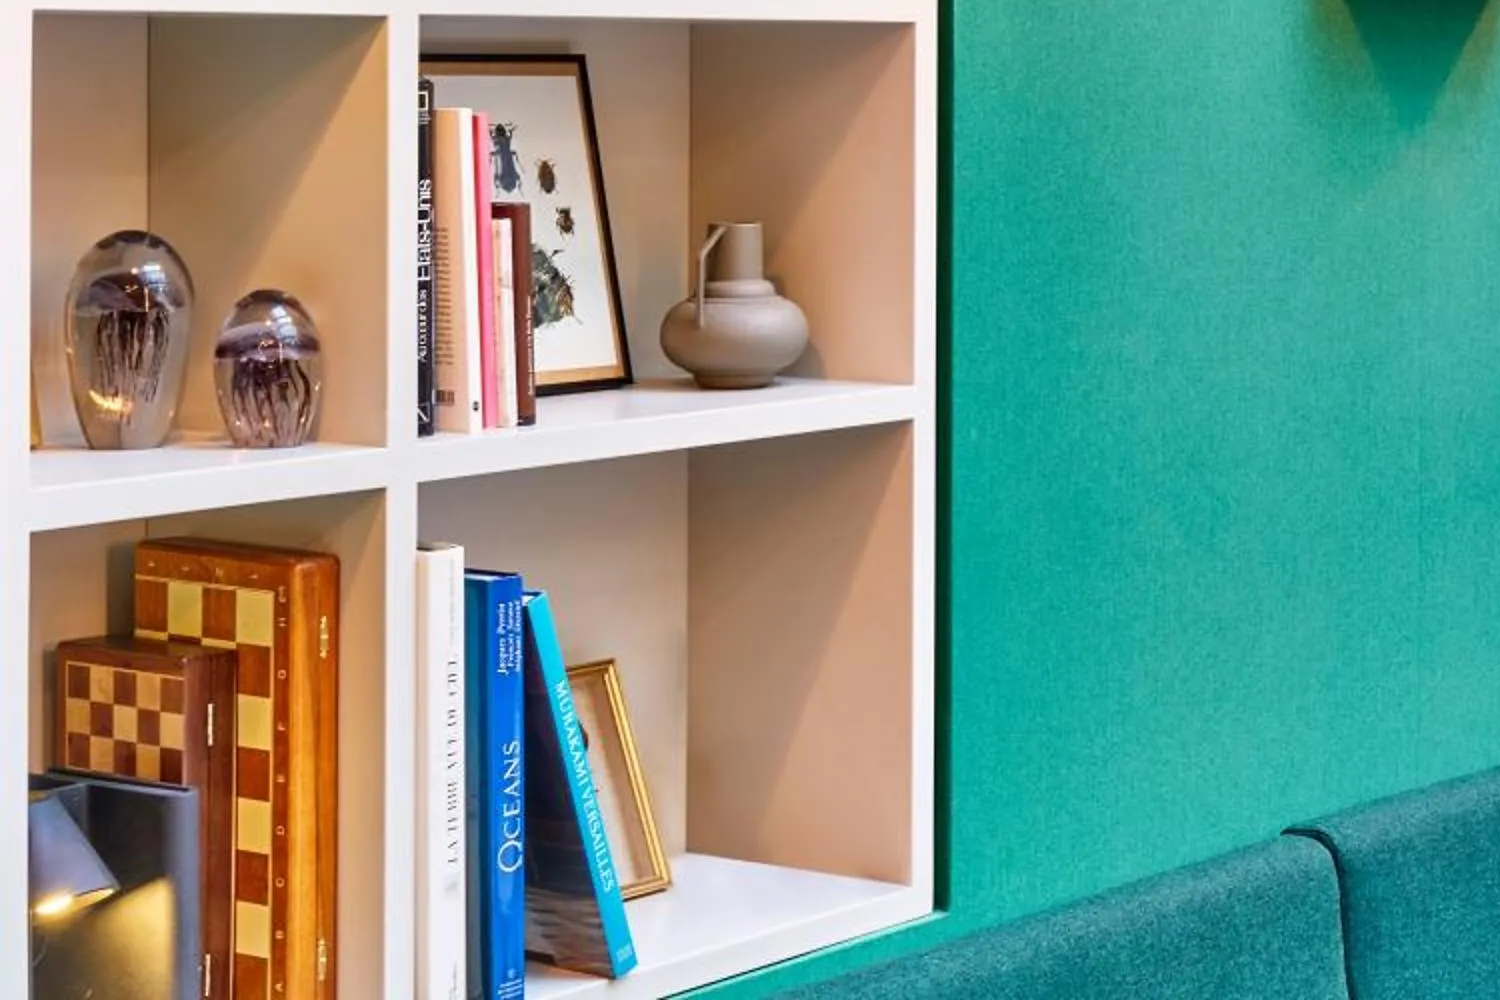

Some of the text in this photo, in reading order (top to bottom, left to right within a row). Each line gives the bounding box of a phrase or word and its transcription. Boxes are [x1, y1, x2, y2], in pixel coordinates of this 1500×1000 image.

[496, 739, 523, 875] OCEANS
[553, 679, 616, 895] MURAKAMI VERSAILLES
